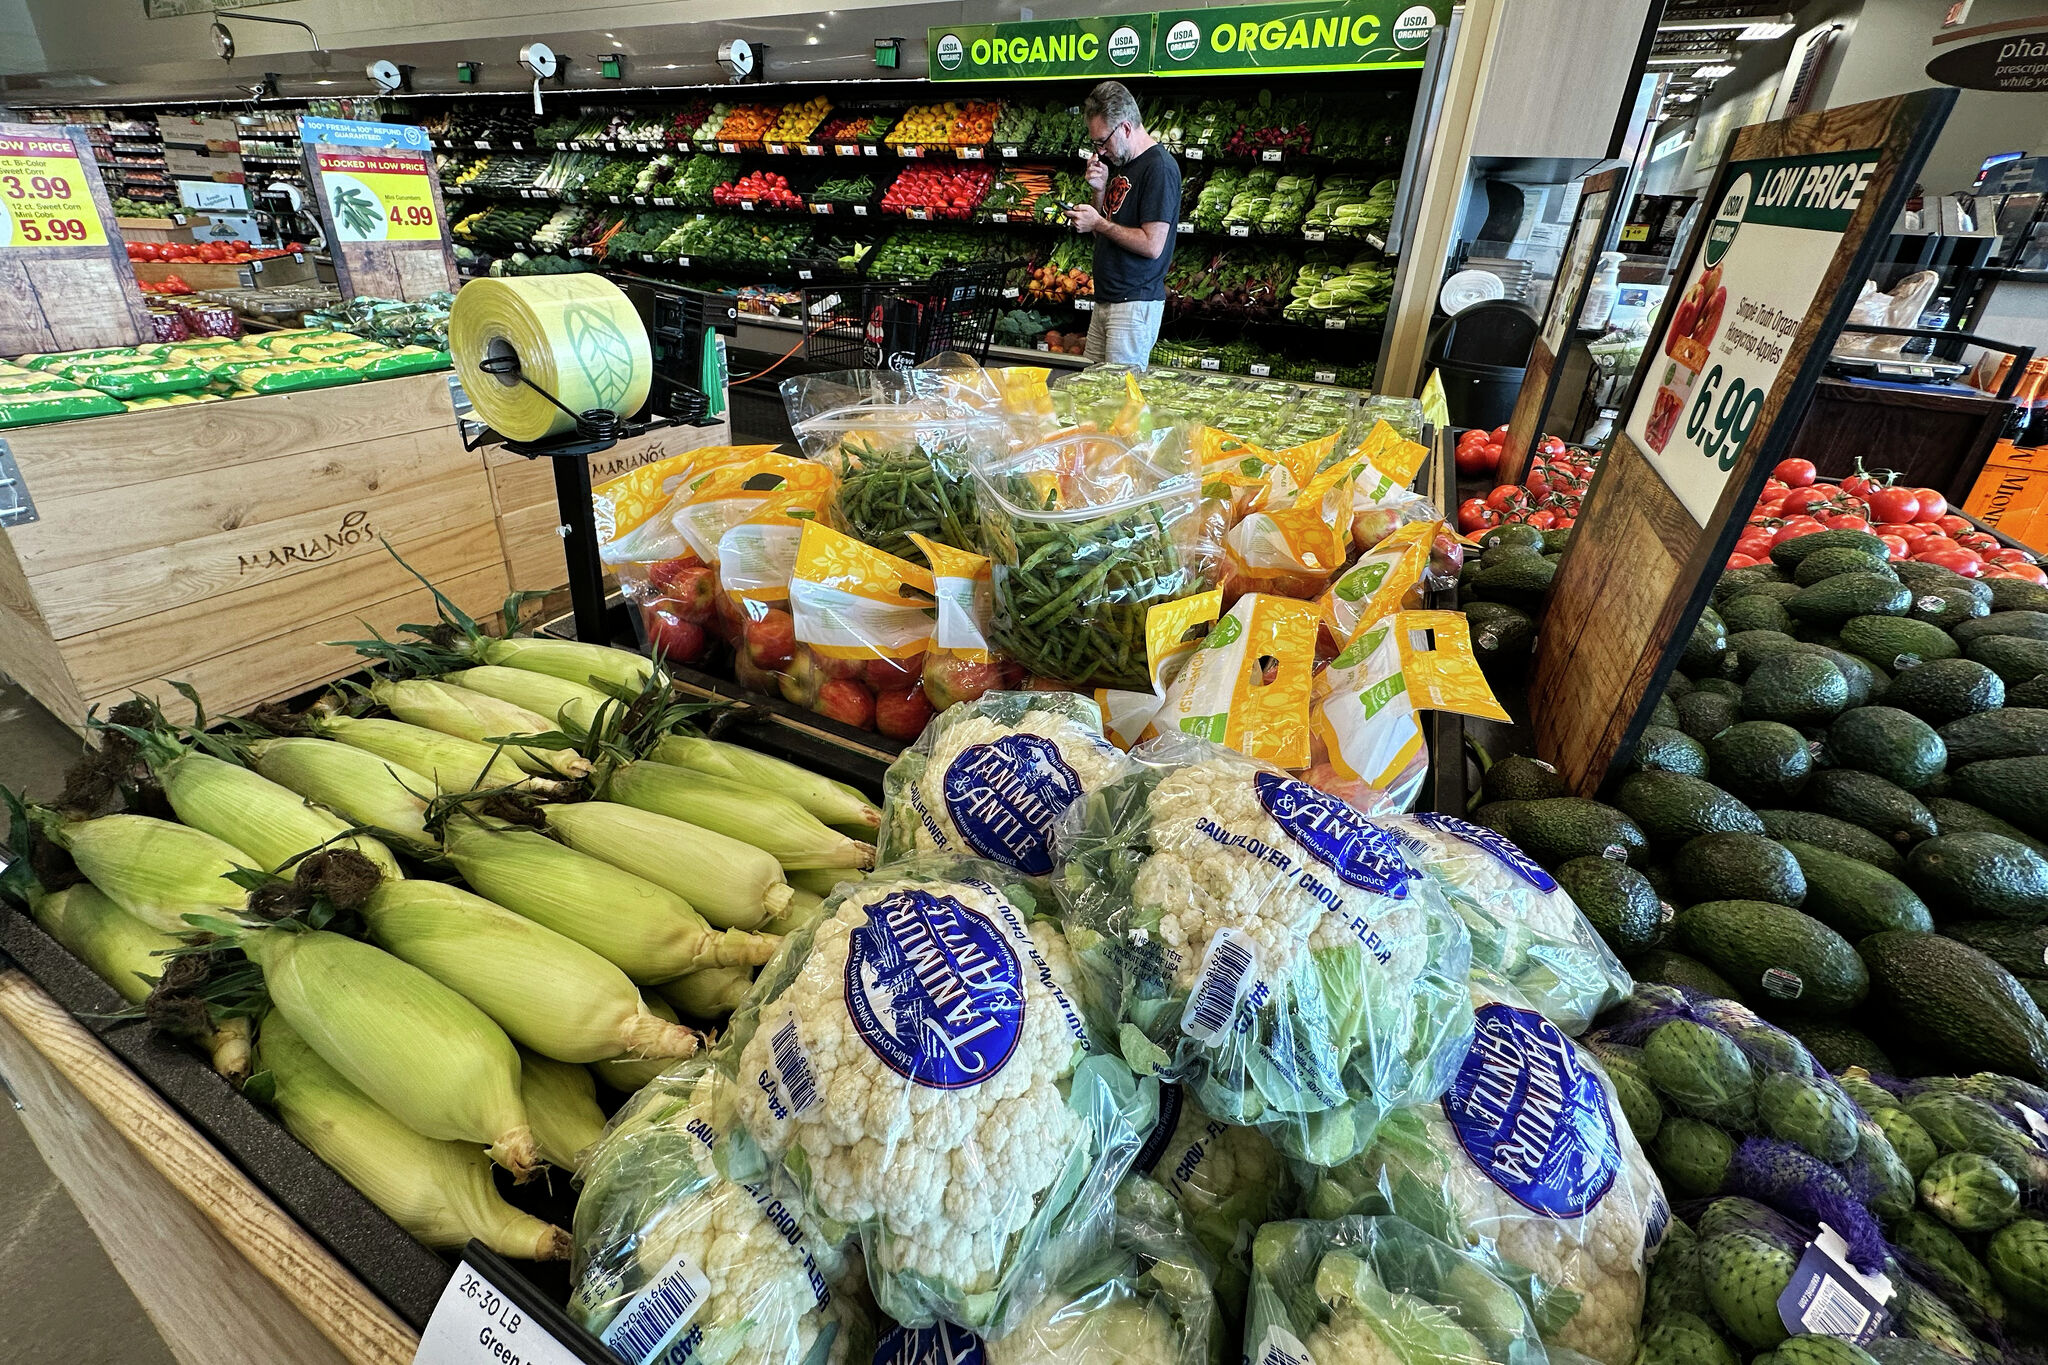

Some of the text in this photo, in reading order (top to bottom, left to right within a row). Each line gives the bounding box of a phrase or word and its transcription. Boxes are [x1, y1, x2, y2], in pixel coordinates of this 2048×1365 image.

[1173, 31, 1194, 40] USDA
[1210, 14, 1381, 54] ORGANIC
[1397, 29, 1430, 40] ORGANIC
[1403, 15, 1427, 27] USDA
[942, 43, 958, 52] USDA
[971, 32, 1099, 66] ORGANIC
[1112, 48, 1136, 57] ORGANIC
[1114, 36, 1134, 46] USDA
[1170, 41, 1196, 52] ORGANIC
[2000, 76, 2034, 87] while
[326, 124, 351, 132] FRESH
[14, 159, 47, 167] Bi-Color
[28, 141, 73, 153] PRICE
[25, 168, 45, 176] Corn
[328, 159, 426, 172] LOCKED IN LOW PRICE
[2, 175, 72, 200] 3.99
[1754, 161, 1878, 211] LOW PRICE
[15, 211, 33, 219] Mini
[63, 203, 82, 211] Corn
[389, 205, 433, 227] 4.99
[1722, 194, 1745, 217] USDA
[19, 218, 88, 242] 5.99
[1735, 296, 1759, 322] Simple
[1754, 303, 1775, 329] Truth
[1724, 321, 1758, 357] Honeycrisp
[1753, 336, 1783, 365] Apples
[1685, 363, 1765, 473] 6.99
[592, 444, 667, 480] MARIANO'S
[239, 517, 375, 576] MARIANO'S
[909, 780, 948, 851] CAULIFLOWER
[946, 775, 1038, 861] & ANTLE
[1275, 794, 1294, 811] &
[953, 804, 1018, 868] PREMIUM FRESH PRODUCE
[1271, 803, 1394, 880] ANTLE
[1288, 821, 1323, 855] PREMIUM
[1344, 868, 1386, 888] PRODUCE
[1194, 816, 1292, 873] CAULIFLOWER
[1297, 872, 1345, 913] CHOU
[1350, 914, 1393, 966] FLEUR
[979, 920, 1002, 942] FRESH
[997, 904, 1026, 941] CHOU
[924, 903, 1026, 1012] & ANTLE
[1001, 940, 1016, 977] PREMIUM
[1137, 935, 1156, 950] HEAD
[1164, 960, 1179, 973] USA
[1207, 946, 1221, 984] 27918
[851, 934, 913, 1066] EMPLOYEE OWNED FAMILY FARM
[1028, 949, 1091, 1051] CAULIFLOWER
[1194, 983, 1210, 1018] 04079
[1466, 1014, 1525, 1131] & ANTLE
[757, 1068, 788, 1121] #4079
[1322, 1096, 1337, 1111] USA
[1492, 1017, 1579, 1186] TANIMURA
[1149, 1086, 1177, 1152] FRESH PRODUCE
[1174, 1140, 1206, 1184] CHOU
[1566, 1191, 1590, 1208] FARM
[765, 1198, 804, 1247] CHOU
[801, 1253, 833, 1312] FLEUR
[458, 1272, 522, 1335] 26-30 LB
[608, 1259, 686, 1346] 0 27918 04079
